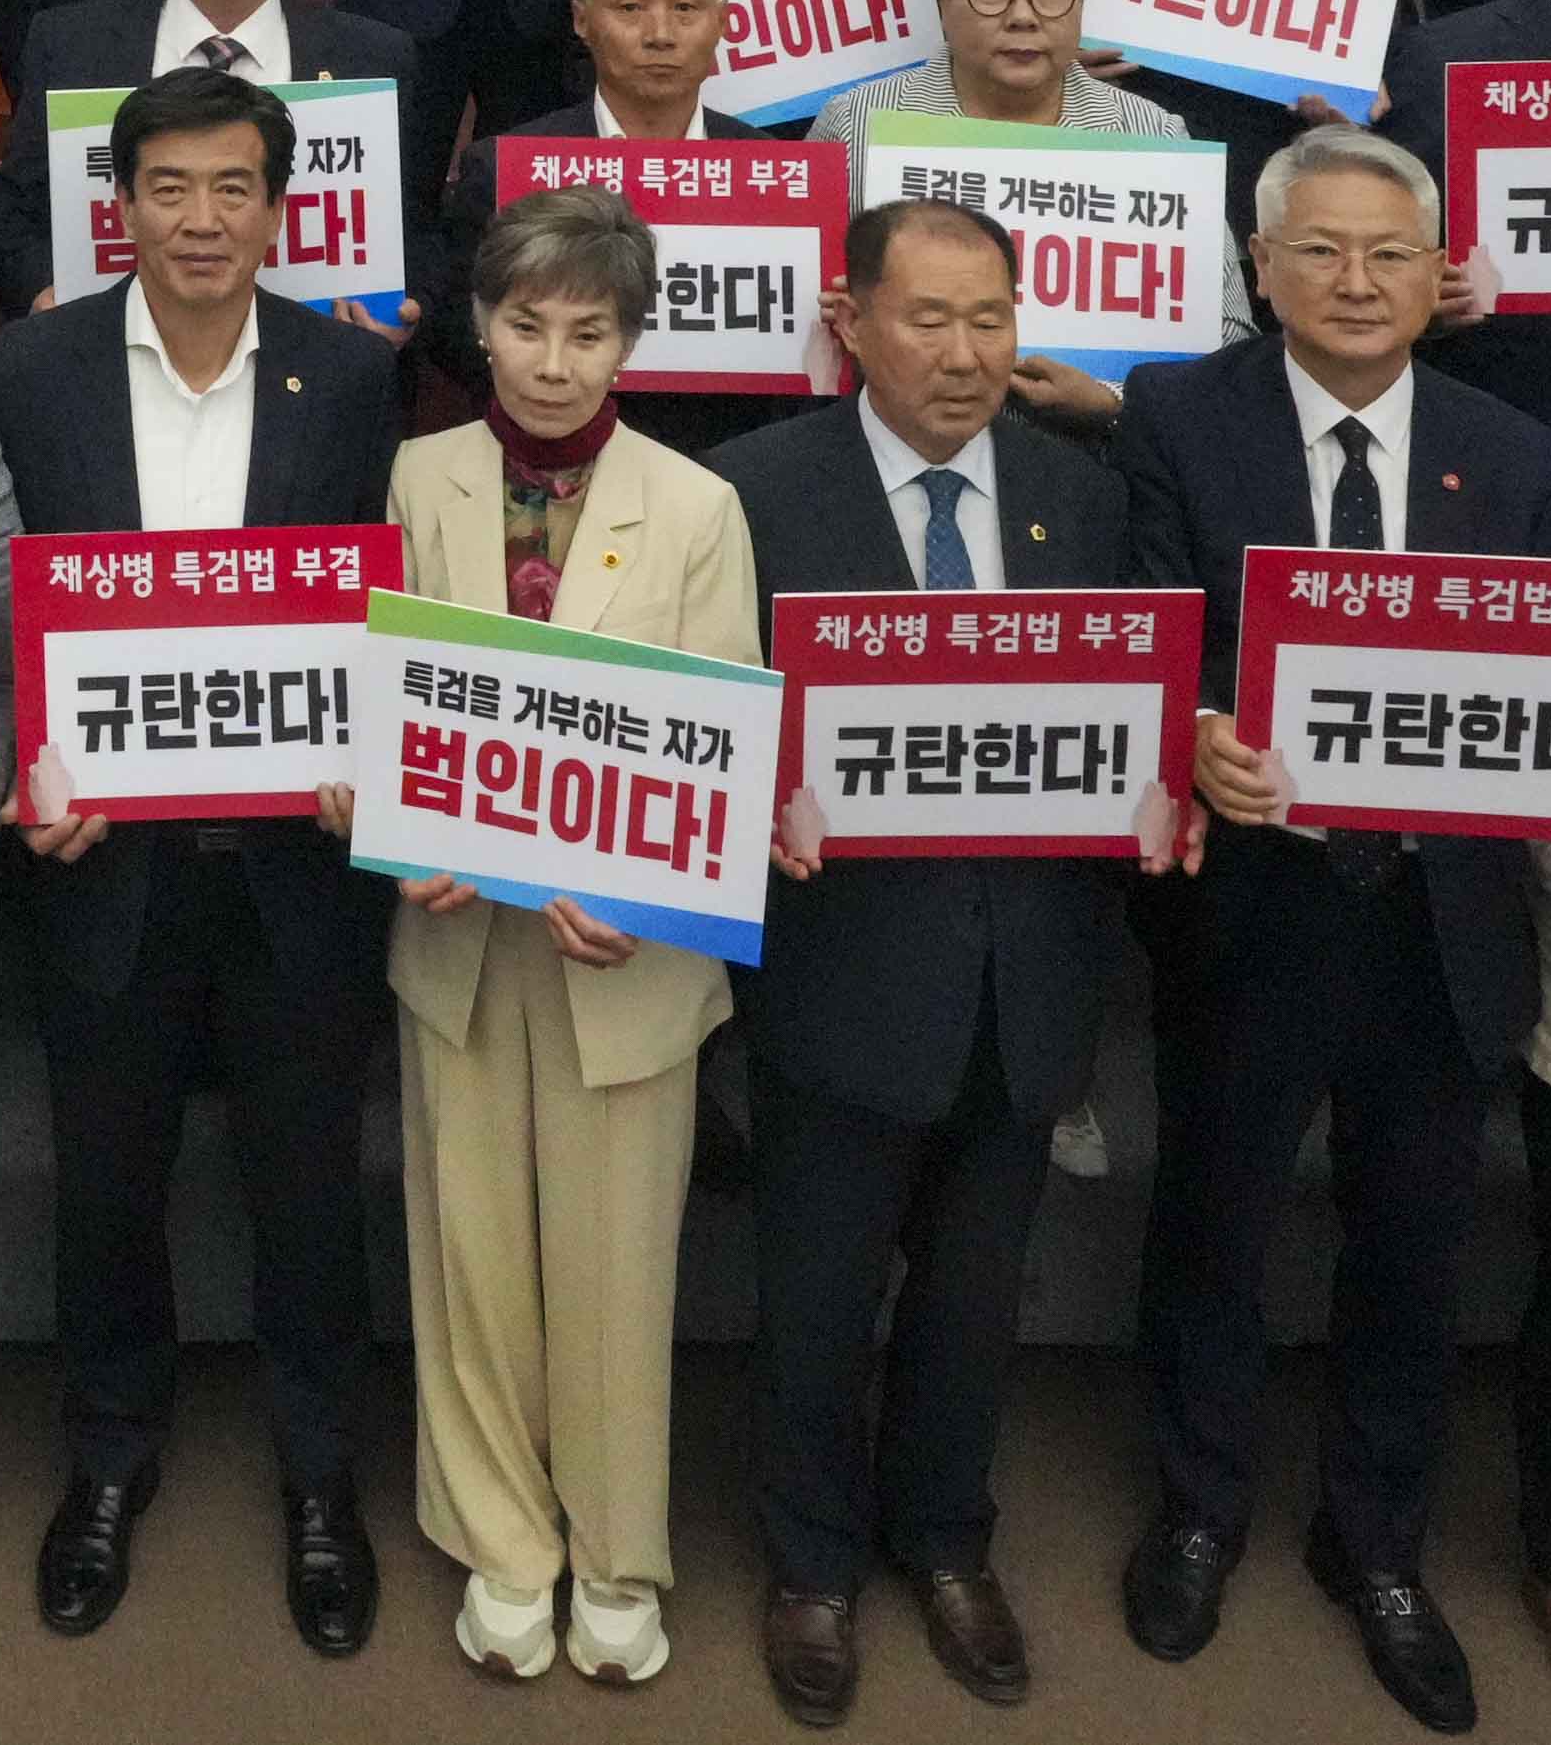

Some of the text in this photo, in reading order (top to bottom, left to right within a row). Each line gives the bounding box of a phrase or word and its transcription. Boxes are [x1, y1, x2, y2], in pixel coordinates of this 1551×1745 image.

[530, 155, 809, 199] 채상병 특검법 부결
[998, 176, 1188, 231] 거부하는 자가
[49, 545, 361, 600] 채상병 특검법 부결
[1289, 570, 1414, 619] 채상병
[814, 612, 1155, 657] 채상병 특검법 부결
[76, 667, 350, 753] 규탄한다!
[403, 659, 734, 773] 특검을 거부하는 자가
[835, 722, 1129, 796] 규탄한다!
[401, 720, 728, 880] 범인이다!
